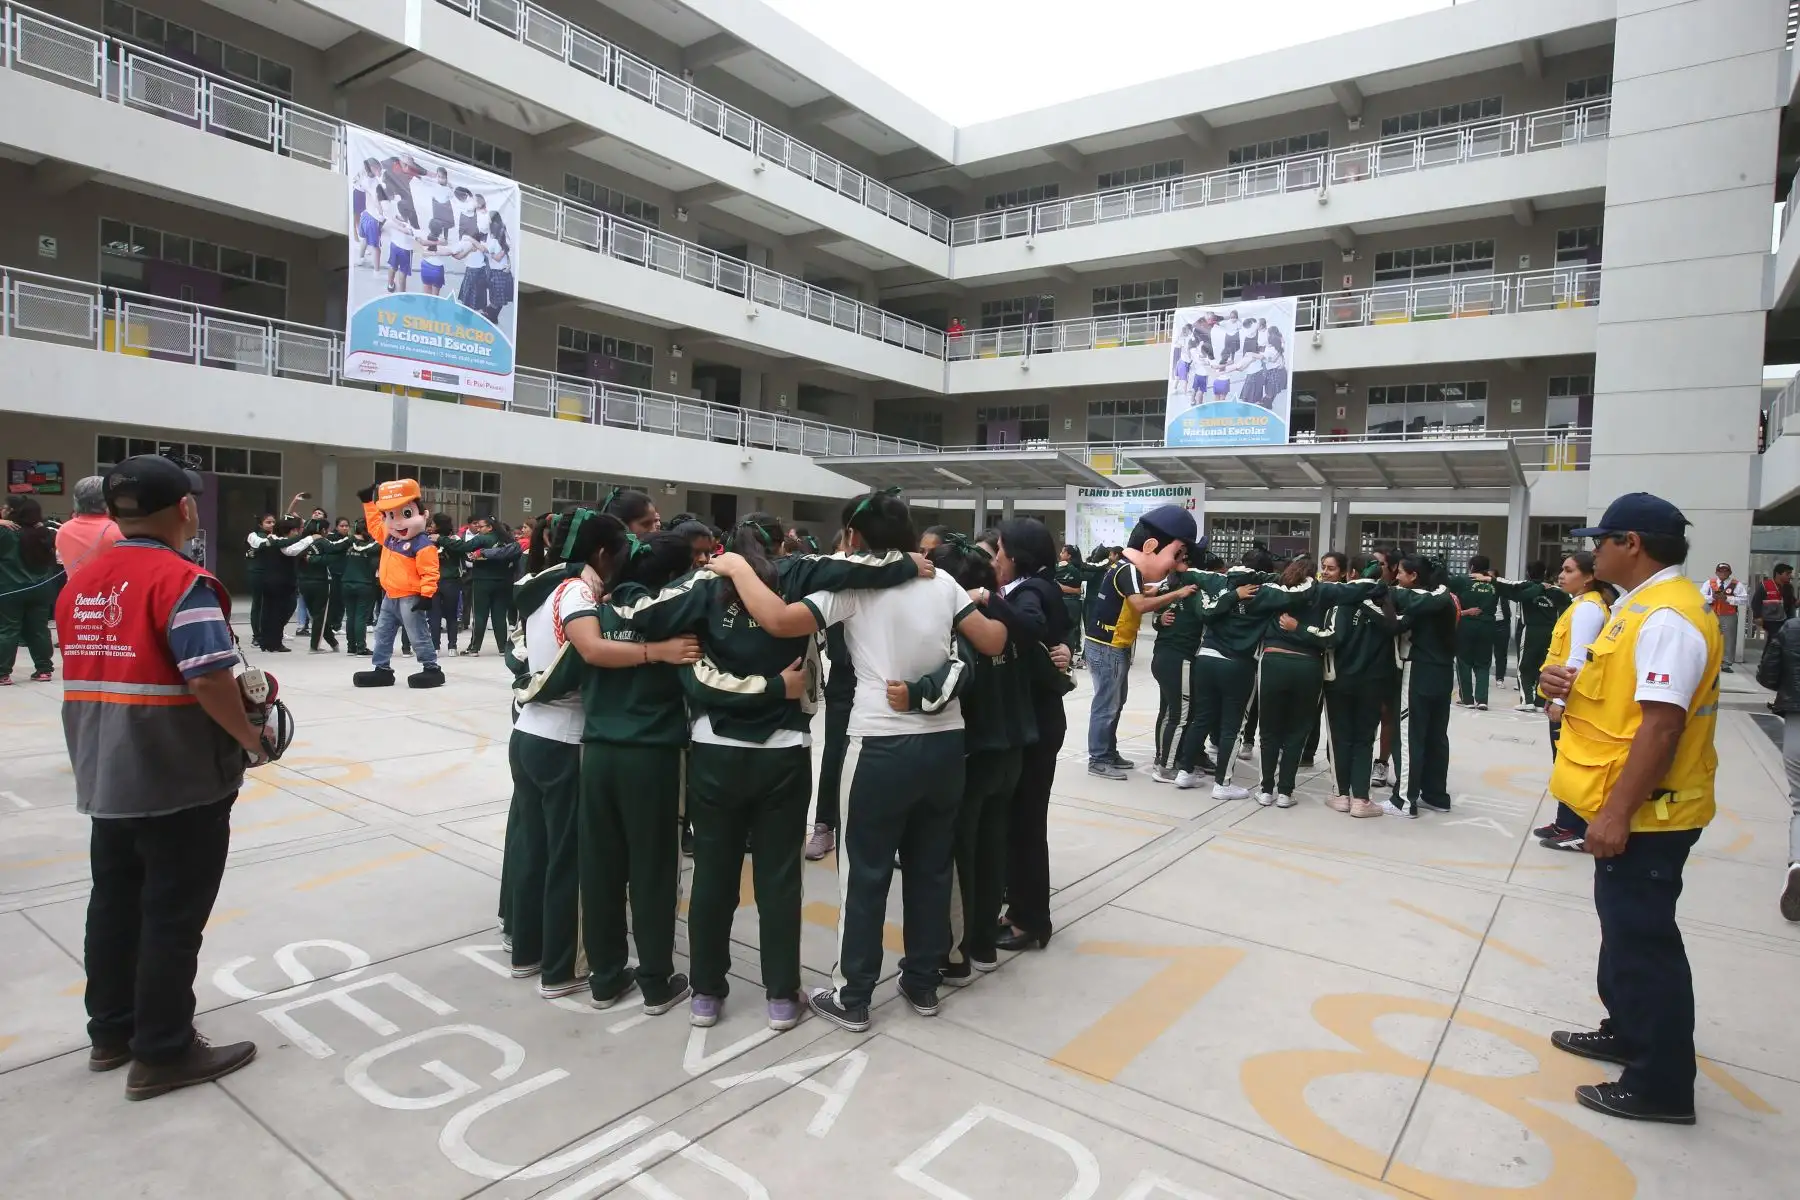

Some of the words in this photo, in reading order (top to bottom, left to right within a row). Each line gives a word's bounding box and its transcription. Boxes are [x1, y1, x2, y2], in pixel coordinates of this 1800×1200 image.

[403, 315, 495, 344] SIMULACRO
[378, 324, 442, 347] Nacional
[444, 337, 492, 356] Escolar
[1183, 427, 1226, 436] Nacional
[1228, 426, 1266, 435] Escolar
[1078, 488, 1110, 497] PLANO
[1112, 489, 1125, 497] DE
[1126, 486, 1192, 497] EVACUACIÓN
